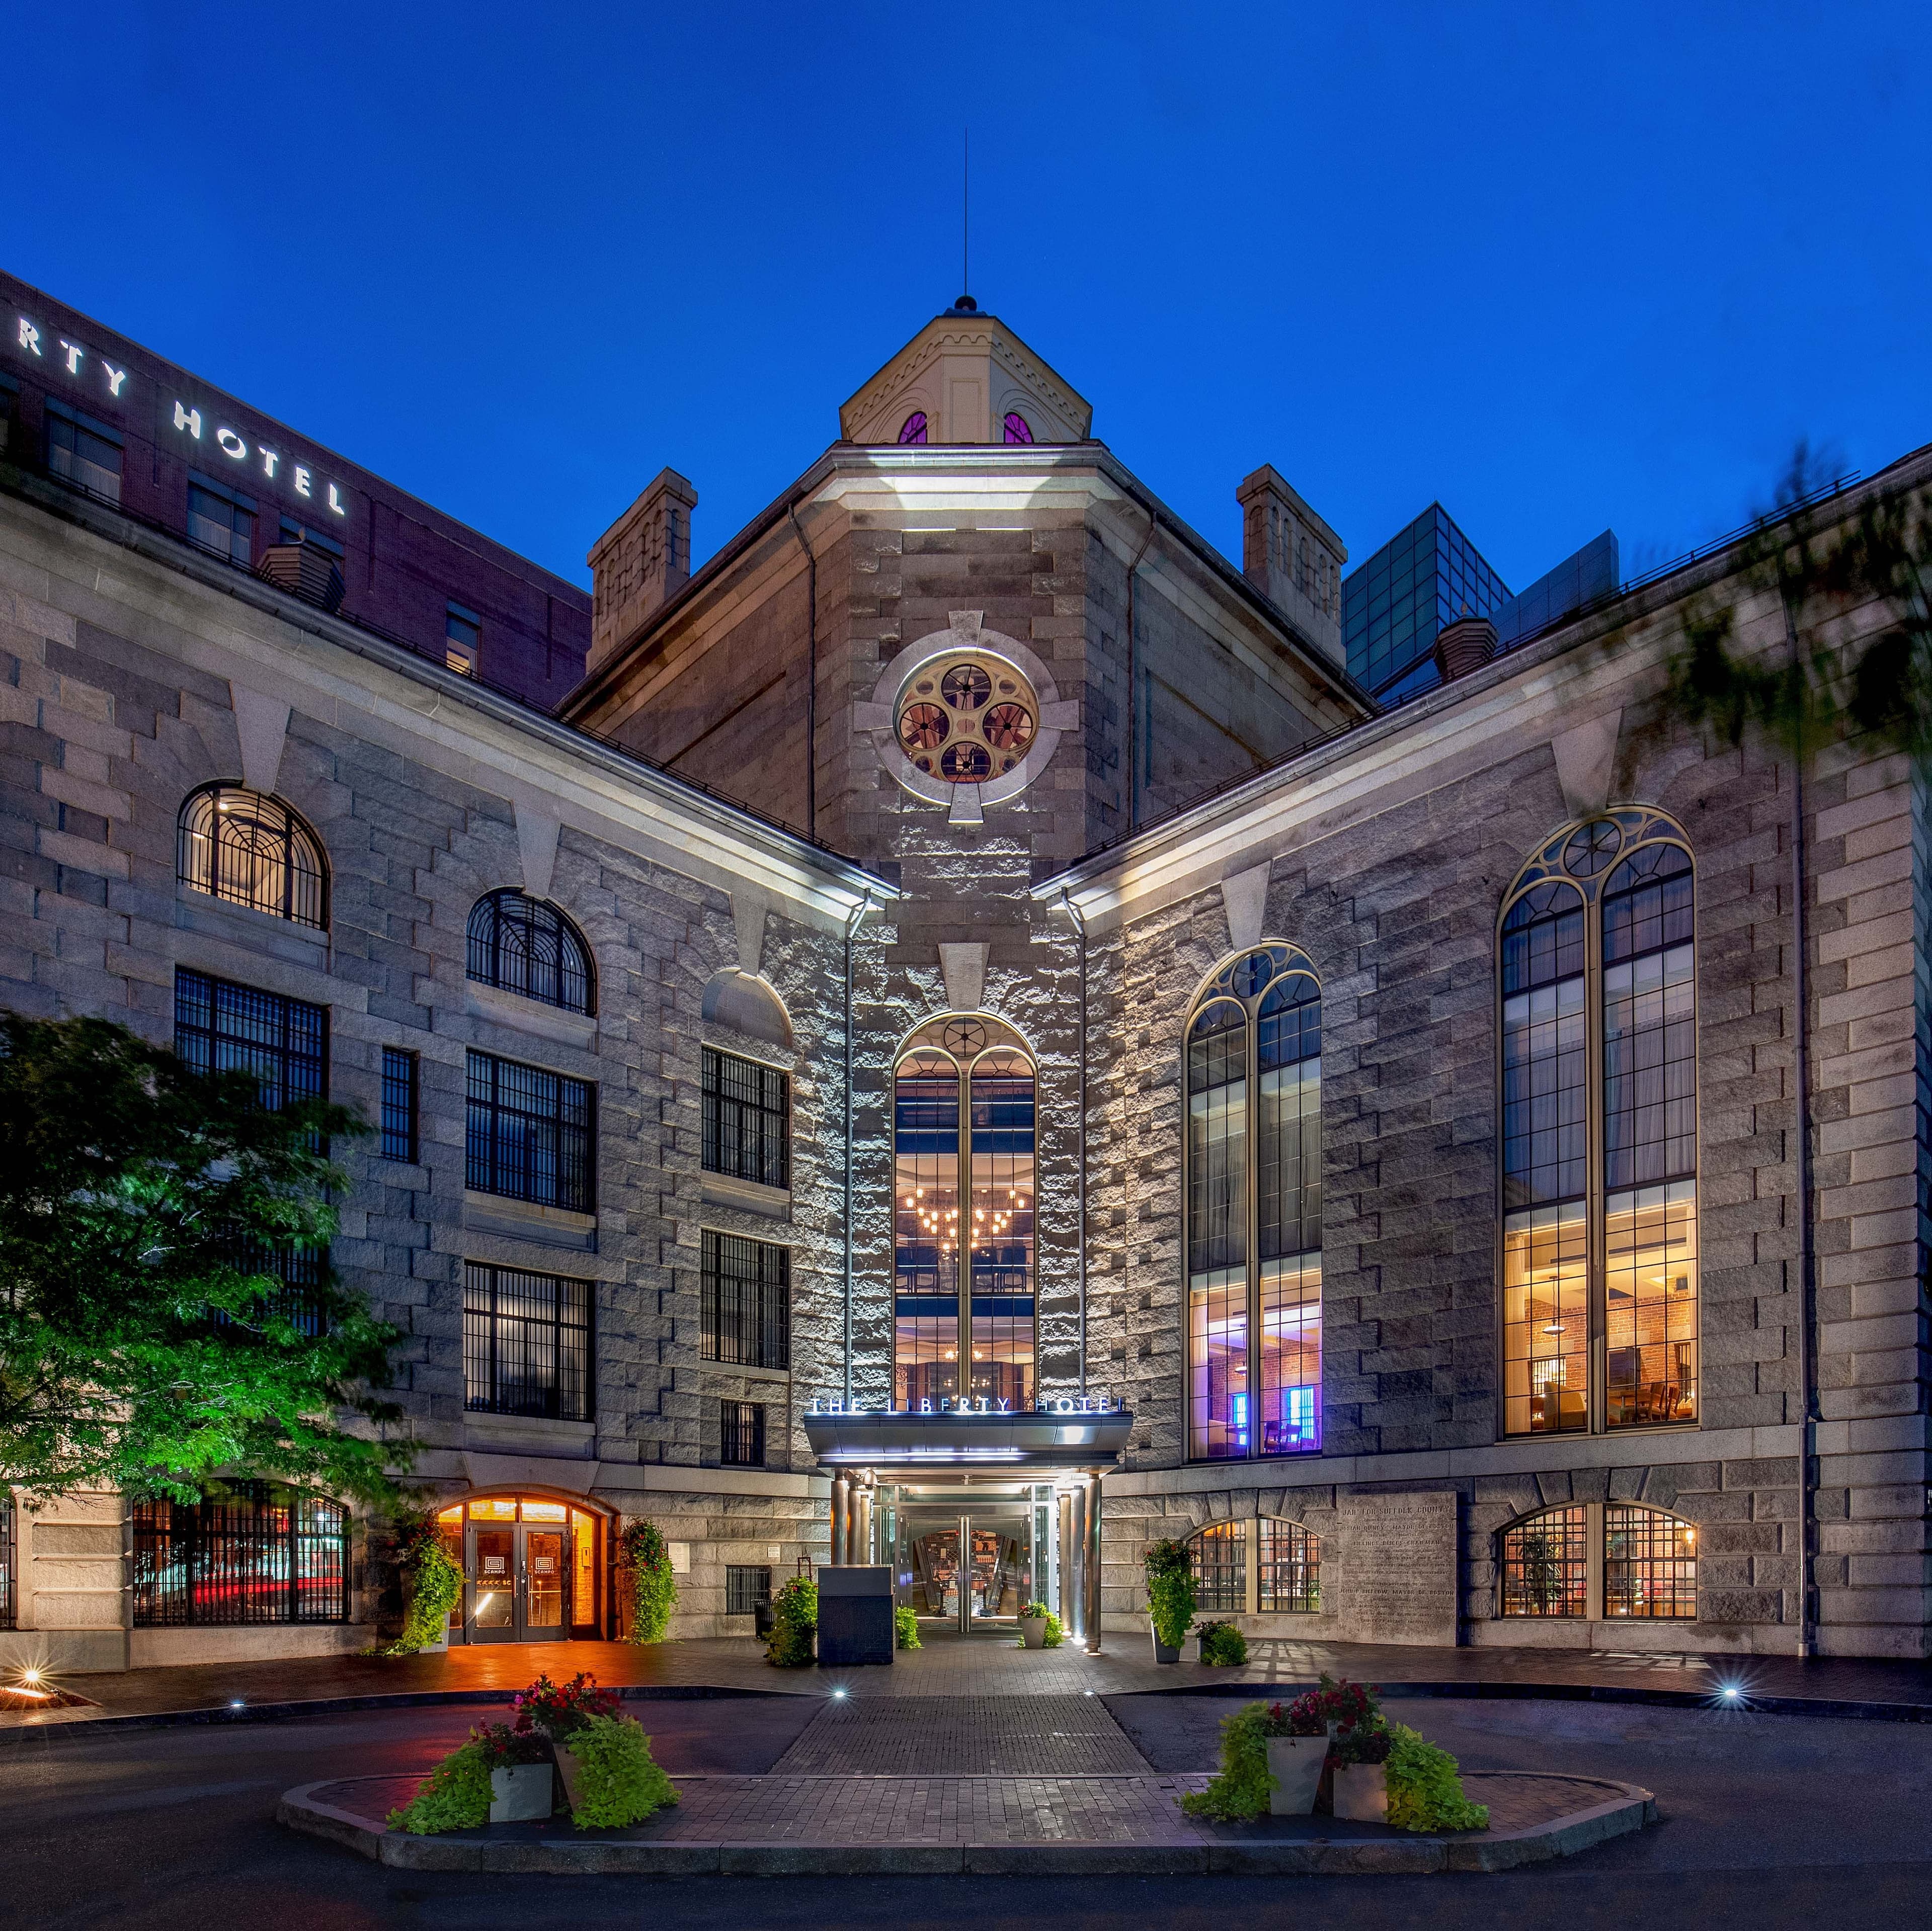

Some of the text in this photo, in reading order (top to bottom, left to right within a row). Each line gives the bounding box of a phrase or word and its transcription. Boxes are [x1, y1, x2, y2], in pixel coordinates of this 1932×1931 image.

[18, 317, 345, 516] RTY HOTEL
[810, 1397, 1123, 1414] THE LIBERTY HOTEL
[1417, 1505, 1451, 1514] COUNTY
